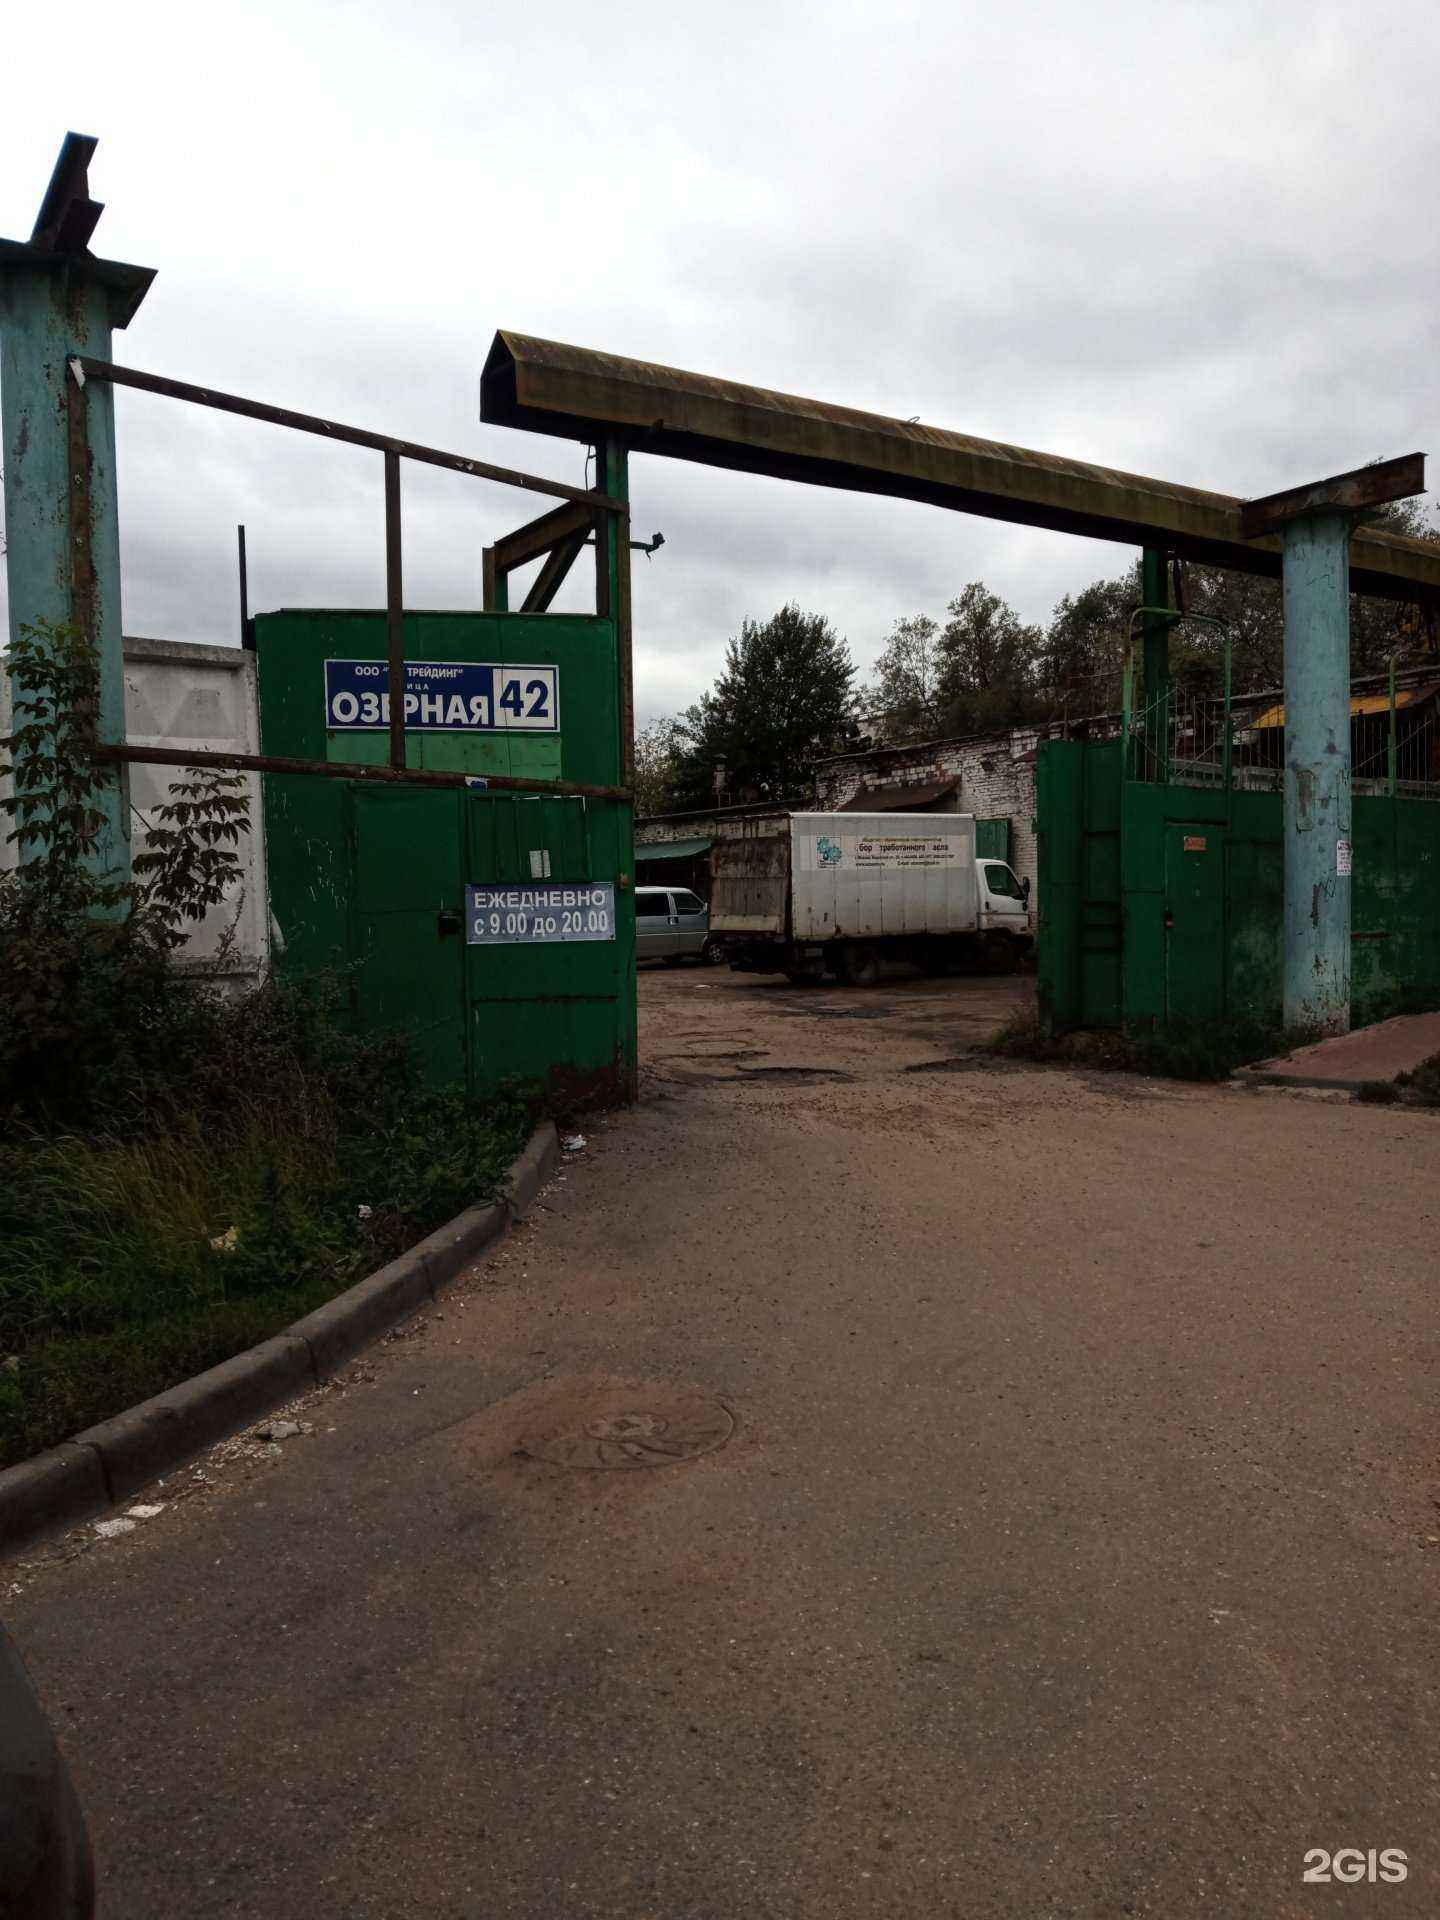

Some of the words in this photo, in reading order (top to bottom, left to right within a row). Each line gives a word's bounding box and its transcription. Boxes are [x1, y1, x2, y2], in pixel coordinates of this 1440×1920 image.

[355, 666, 380, 676] ООО
[500, 680, 549, 718] 42
[474, 889, 606, 910] ЕЖЕДНЕВНО
[474, 918, 484, 935] с
[489, 912, 527, 935] 9.00
[532, 917, 557, 936] до
[561, 910, 608, 933] 20.00
